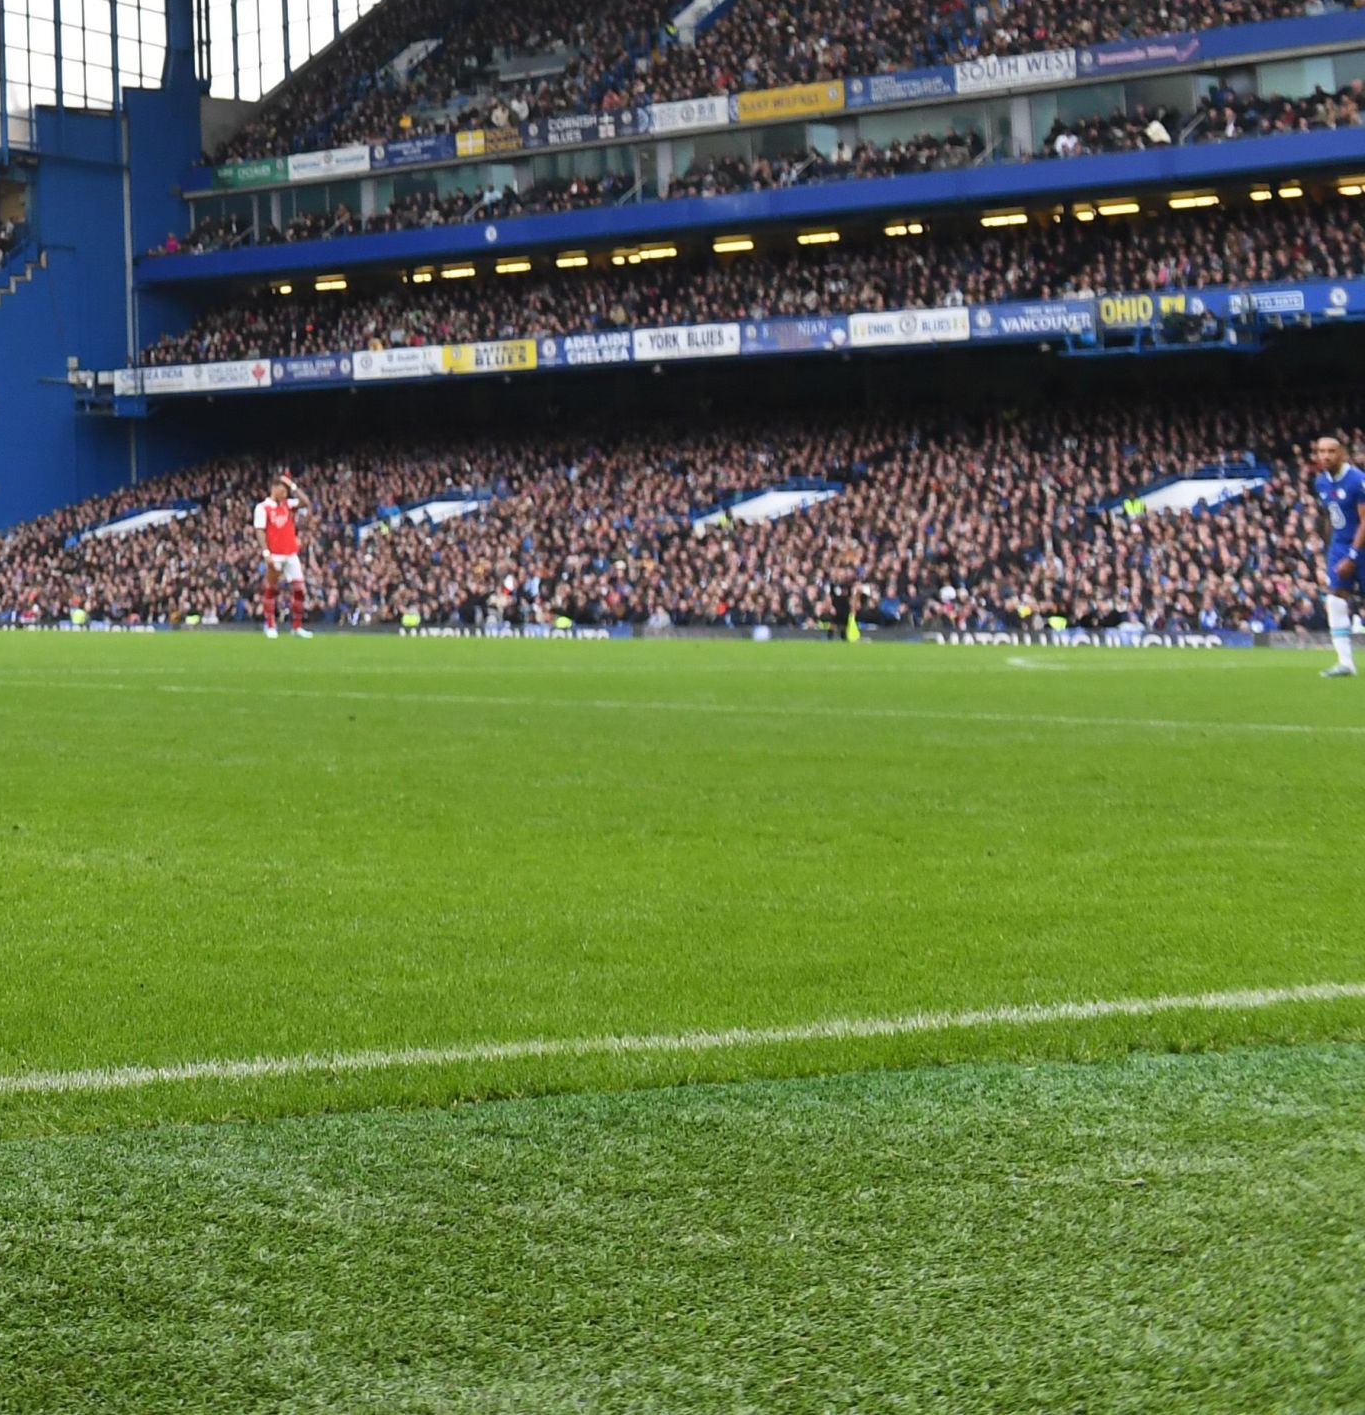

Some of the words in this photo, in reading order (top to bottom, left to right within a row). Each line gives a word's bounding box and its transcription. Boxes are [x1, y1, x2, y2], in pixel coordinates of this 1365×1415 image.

[1099, 295, 1153, 325] OHIO
[999, 312, 1092, 332] VANCOUVER
[649, 333, 681, 350] YORK
[687, 329, 725, 348] BLUES
